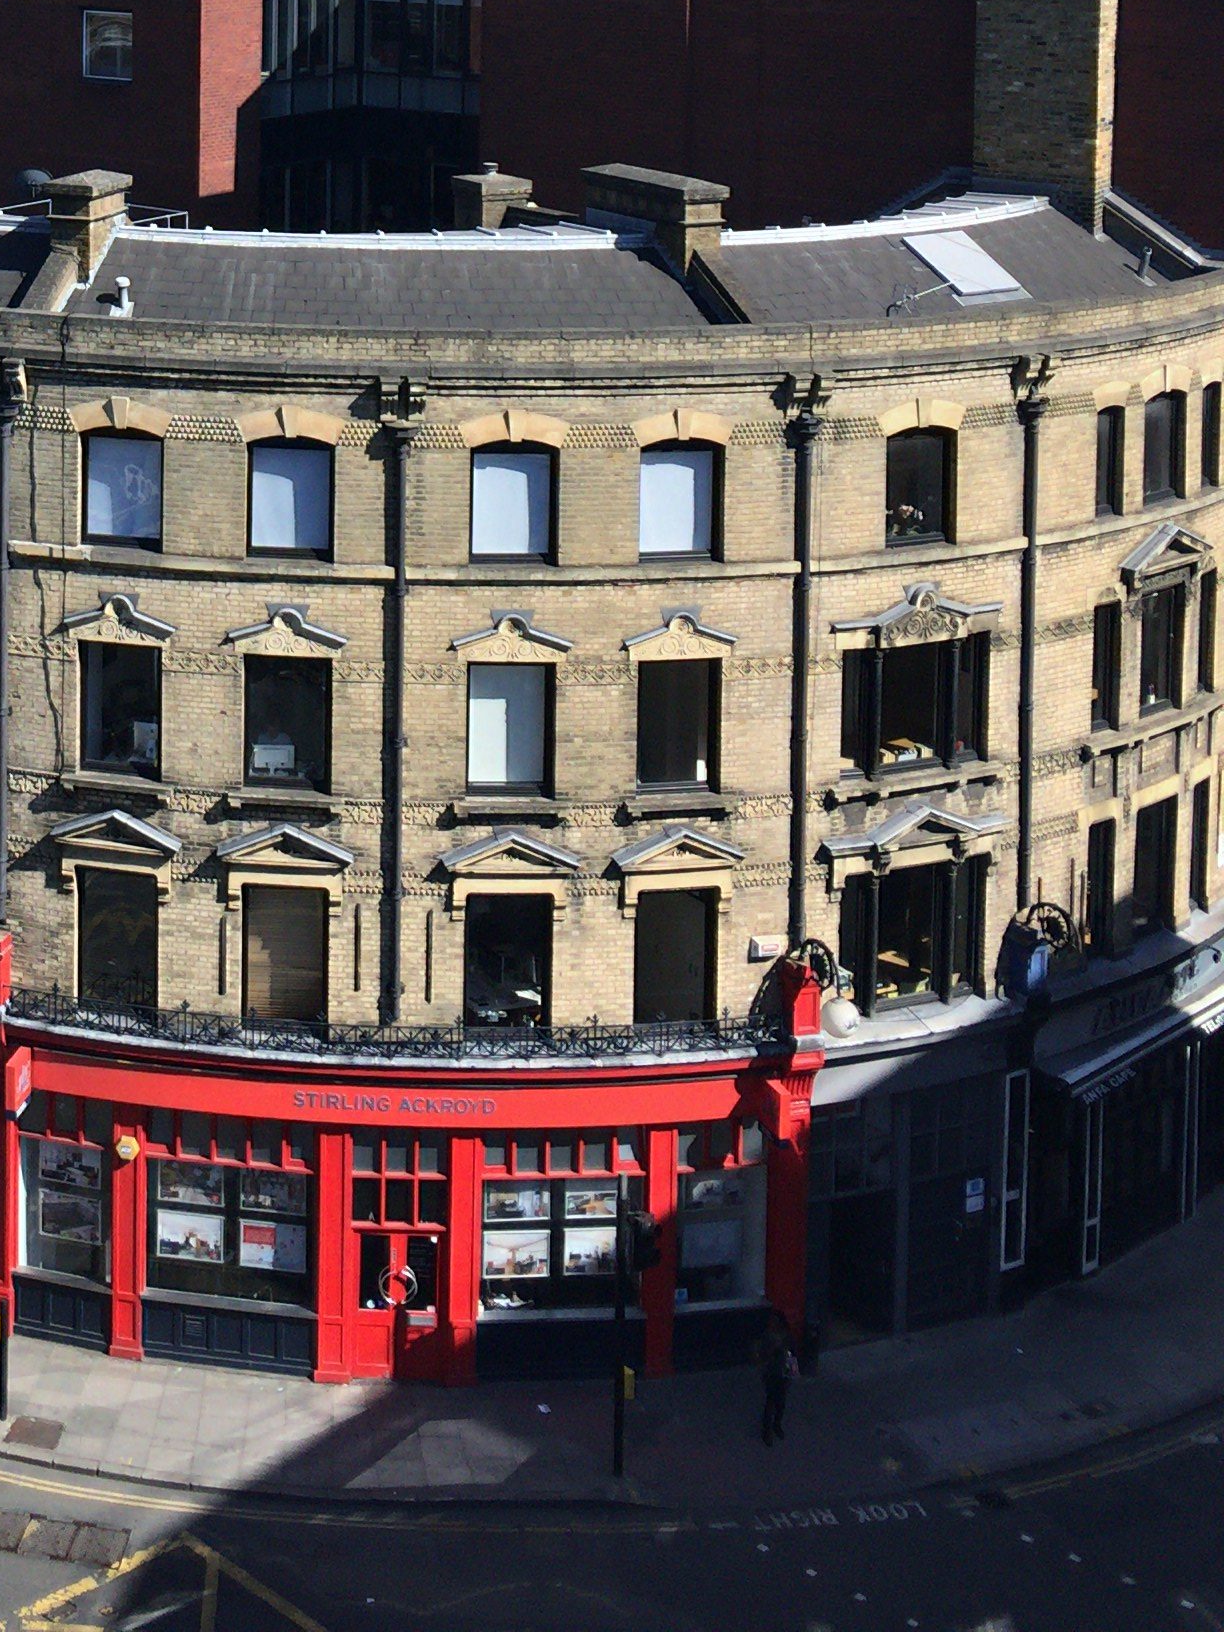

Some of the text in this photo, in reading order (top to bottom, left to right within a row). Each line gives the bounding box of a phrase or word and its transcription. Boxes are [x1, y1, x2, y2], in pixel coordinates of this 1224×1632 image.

[293, 1090, 496, 1115] STIRLING ACKROYD
[754, 1501, 927, 1532] LOOK RIGHT
